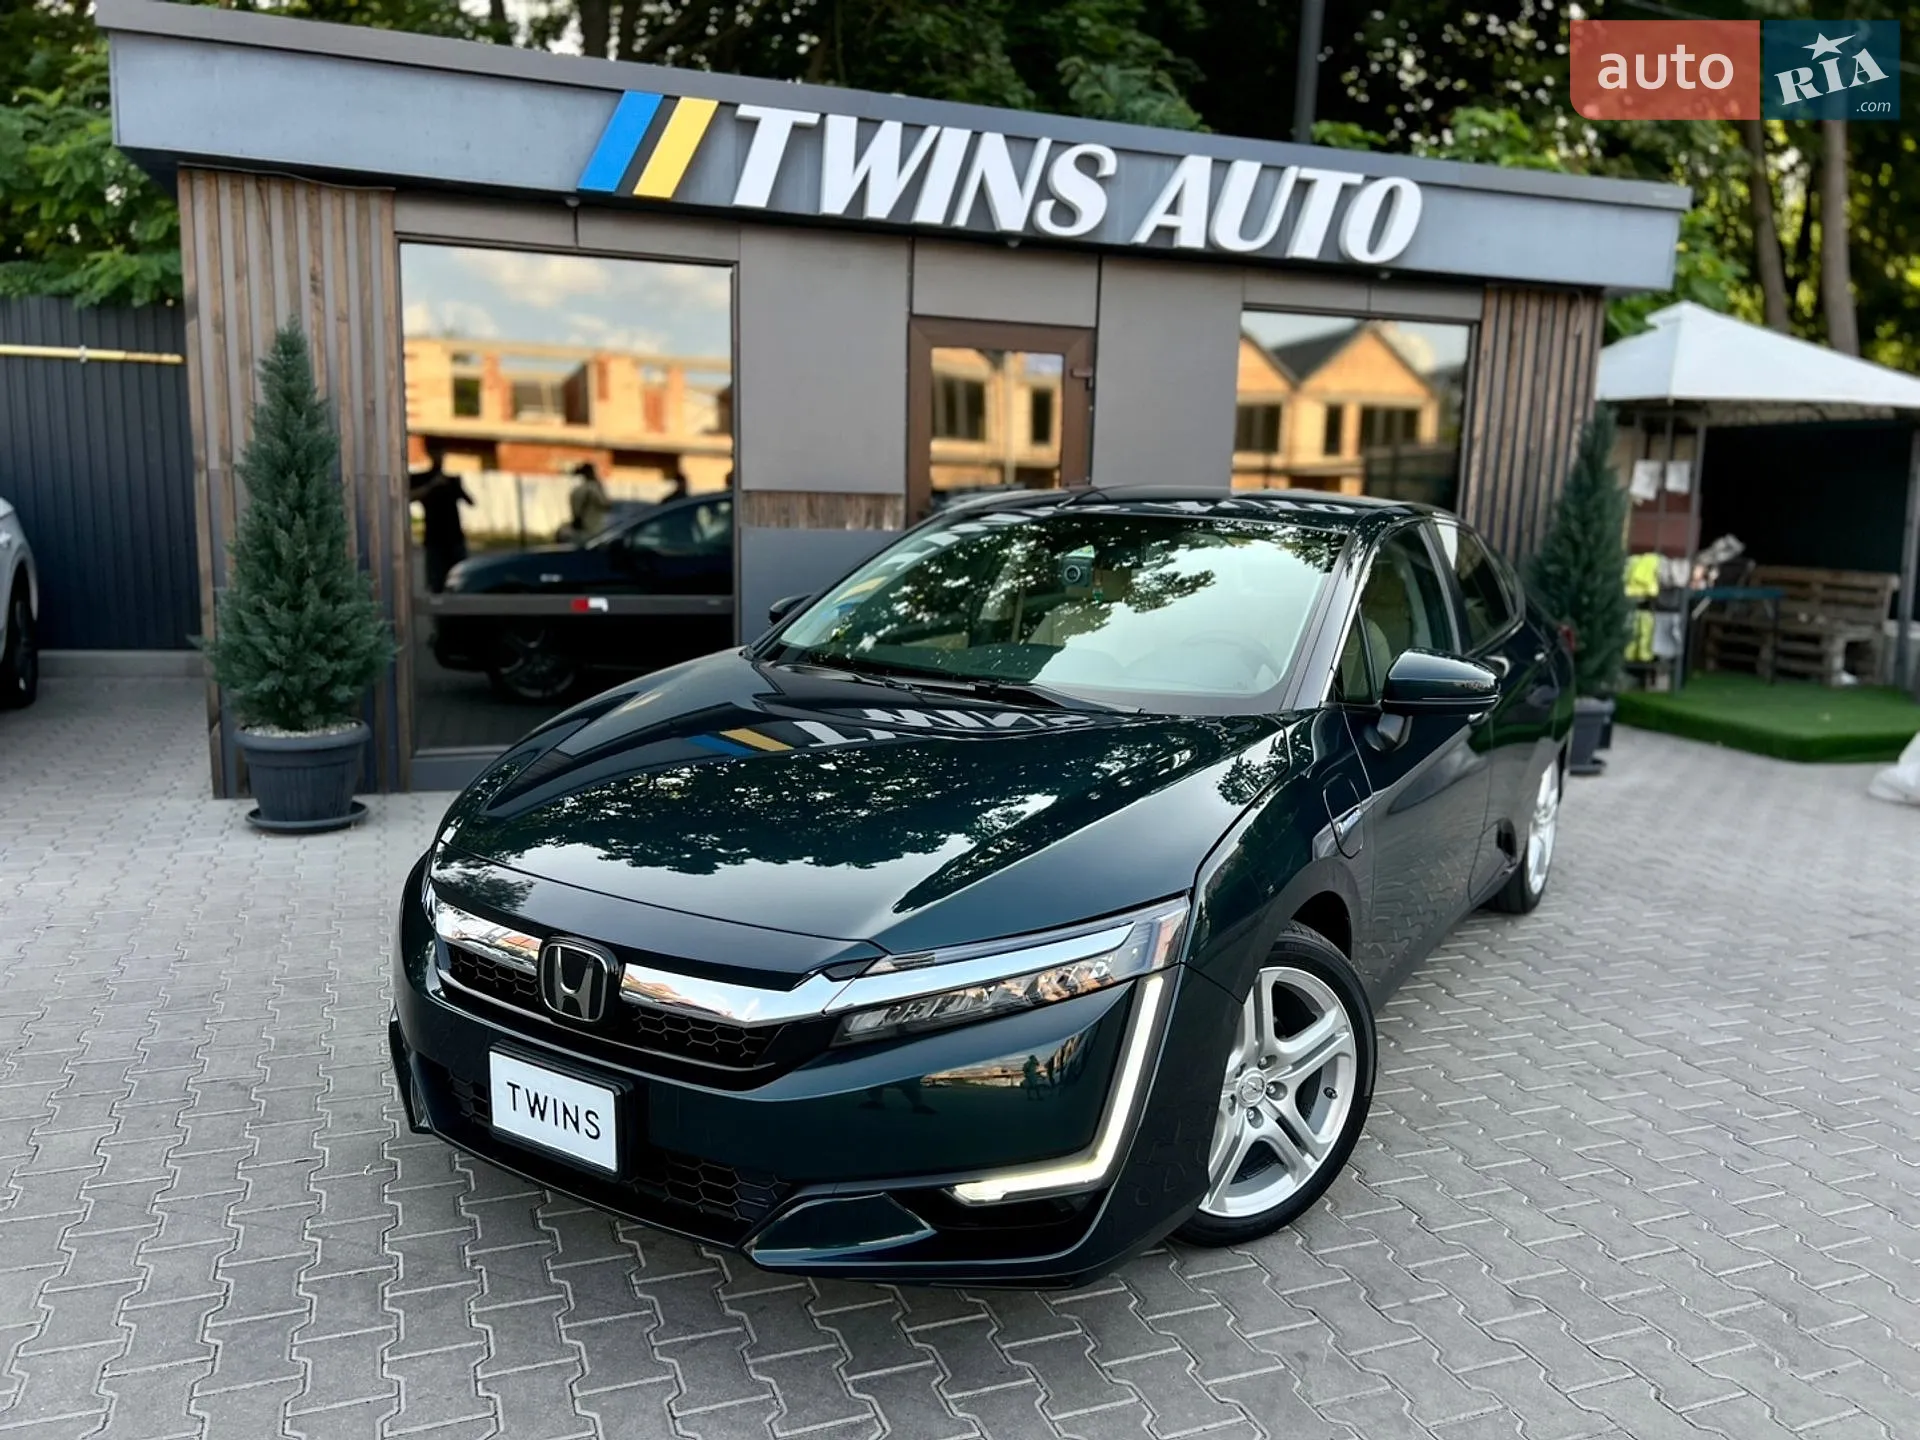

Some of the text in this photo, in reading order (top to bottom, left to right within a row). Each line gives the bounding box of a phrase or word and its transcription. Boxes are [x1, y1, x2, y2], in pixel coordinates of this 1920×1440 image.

[733, 104, 1424, 265] TWINS AUTO
[506, 1081, 601, 1141] TWINS
